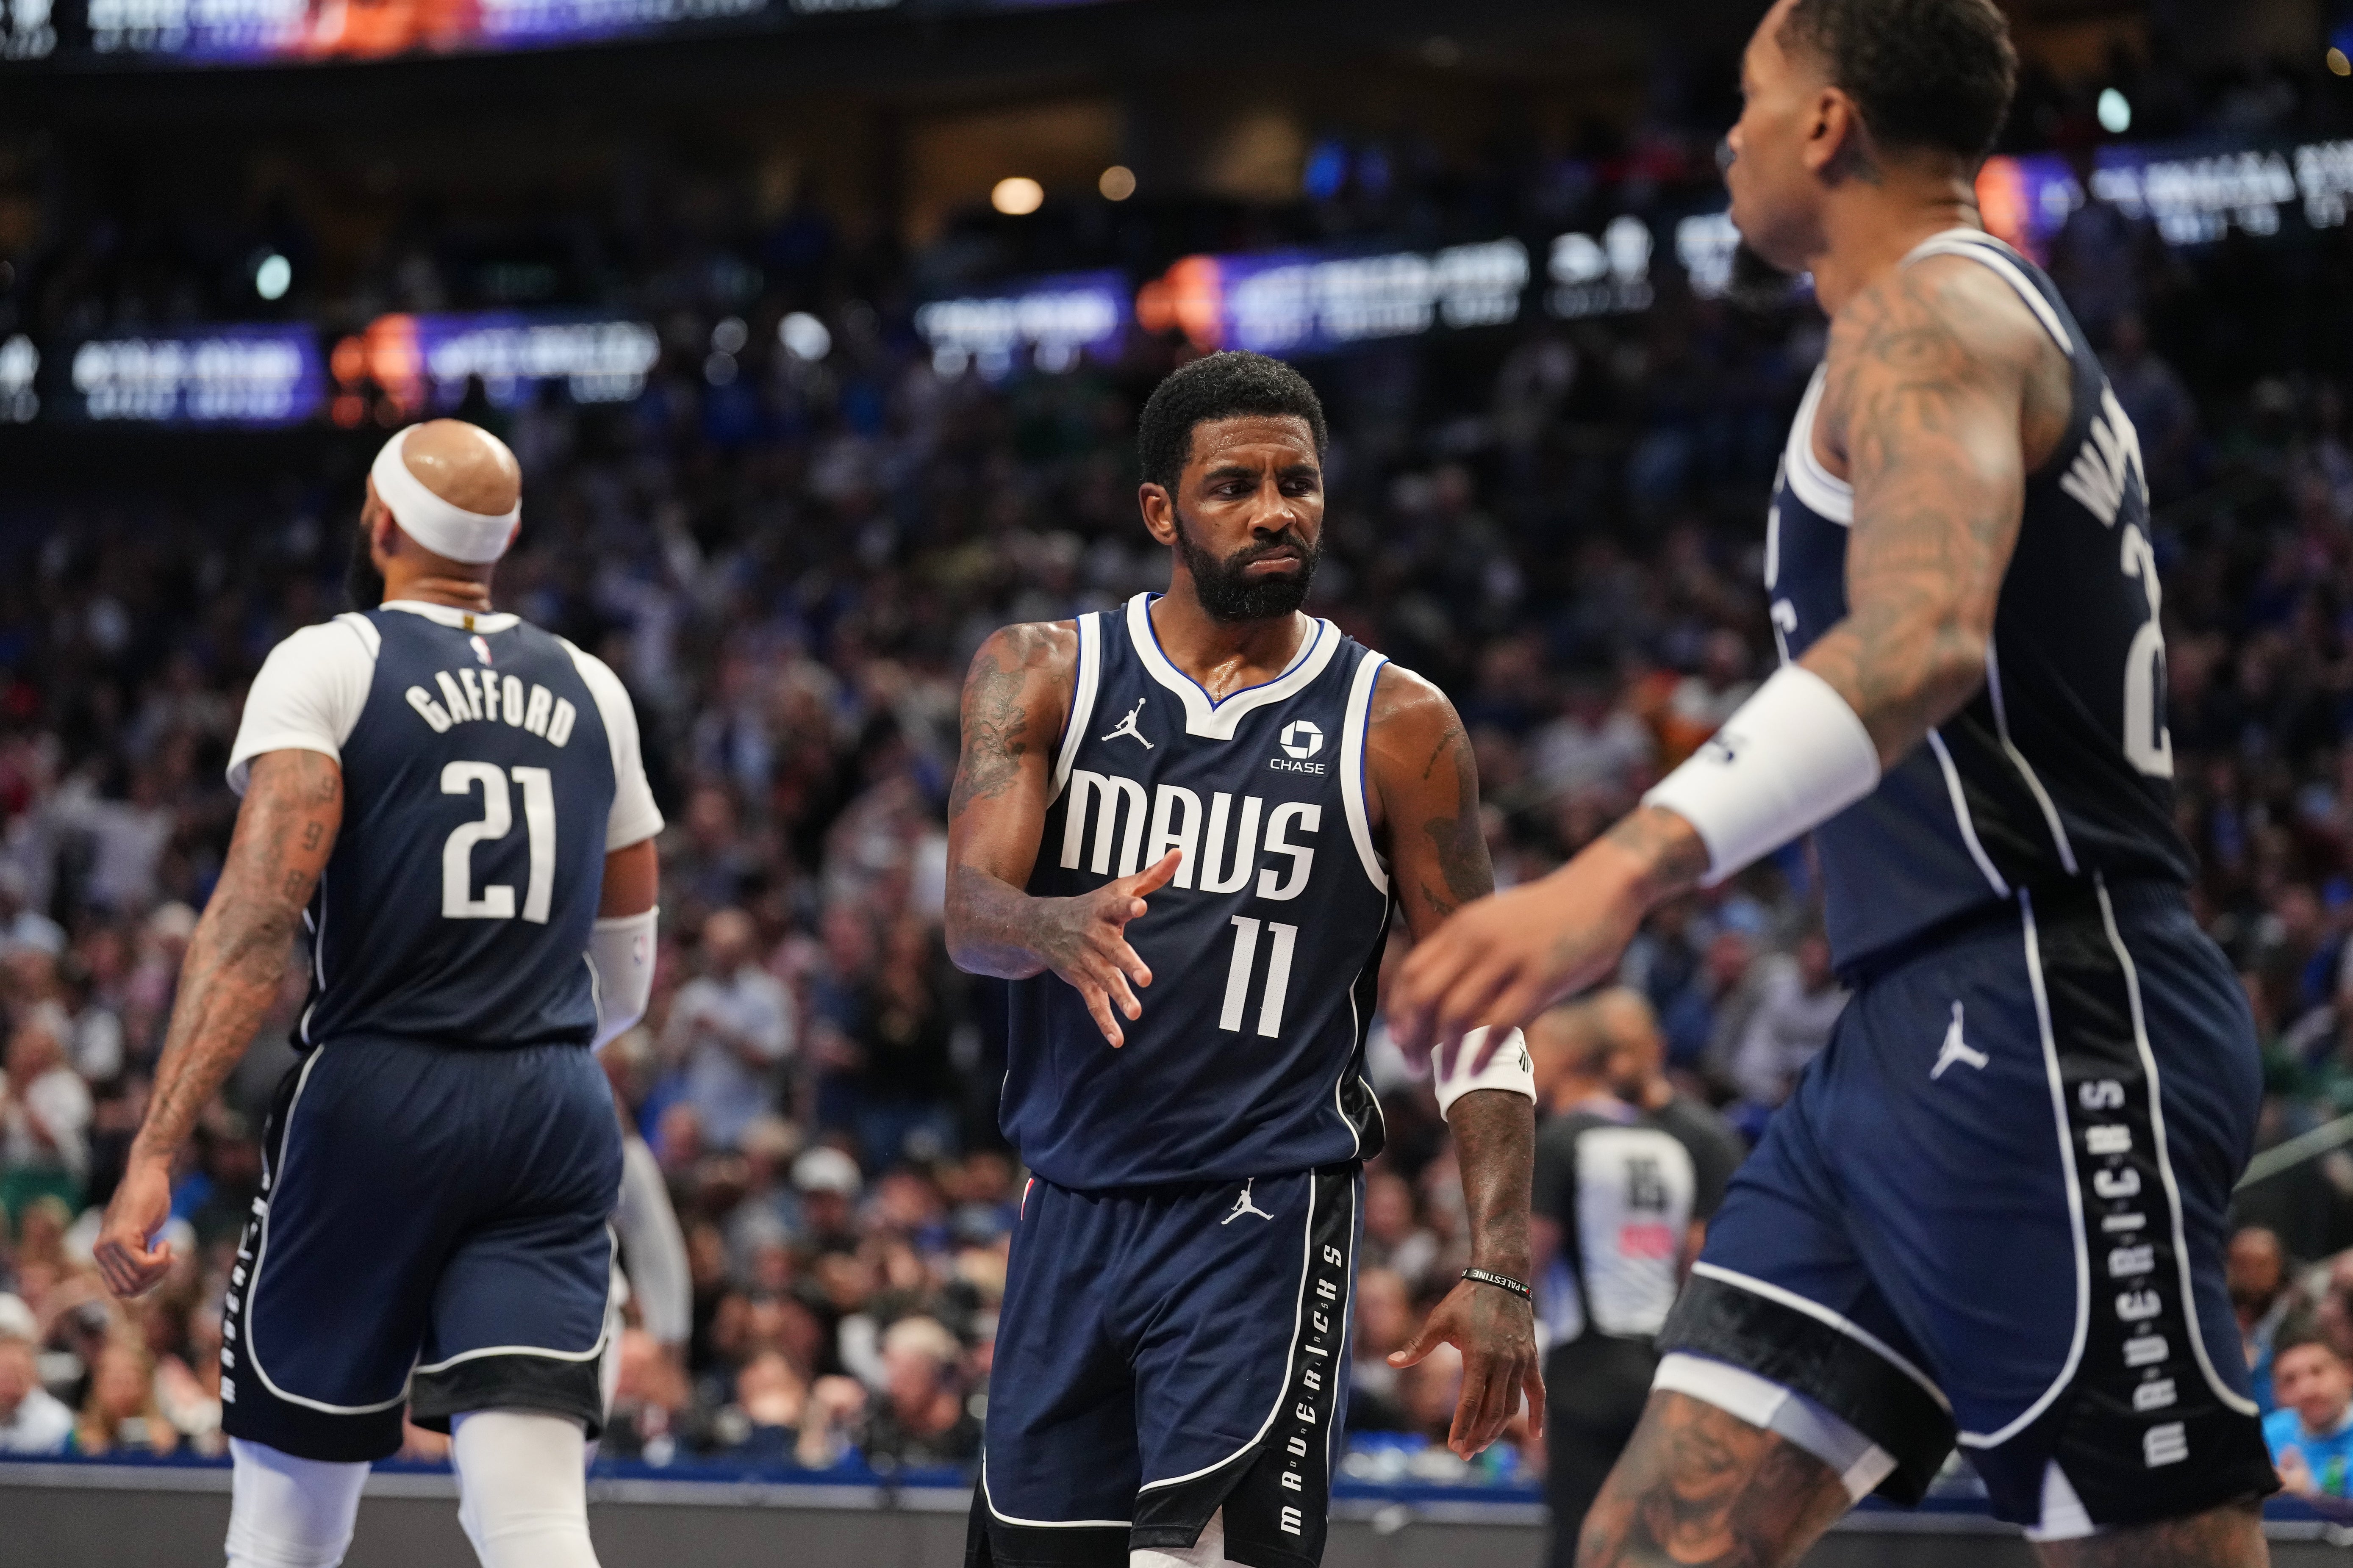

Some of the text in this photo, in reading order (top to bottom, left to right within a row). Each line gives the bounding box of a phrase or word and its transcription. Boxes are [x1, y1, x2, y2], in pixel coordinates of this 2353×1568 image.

[405, 668, 577, 748] GAFFORD
[1270, 758, 1325, 774] CHASE
[441, 760, 557, 924] 21
[1060, 769, 1322, 901] MAVS
[1219, 915, 1298, 1039] 11
[1473, 1270, 1522, 1291] PALESTINE
[2078, 1078, 2189, 1468] MAVERICKS
[1280, 1244, 1342, 1536] MAVERICKS
